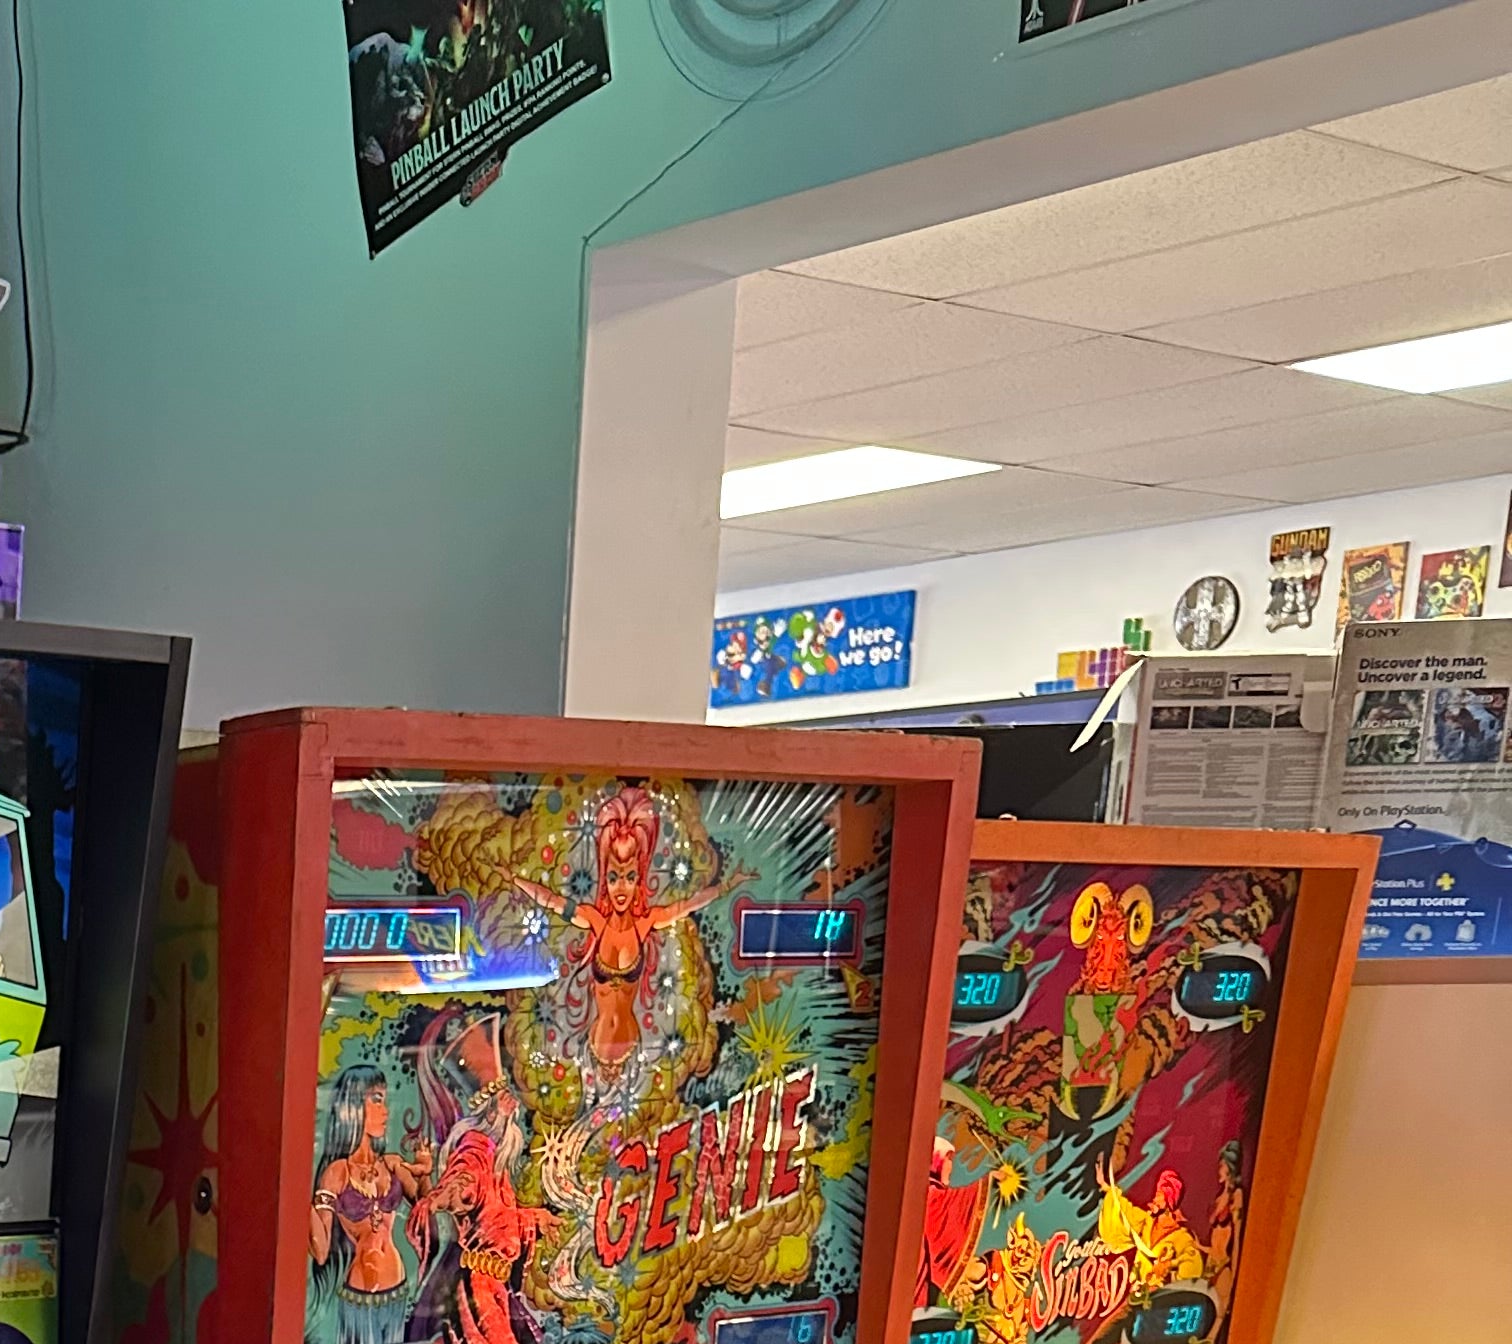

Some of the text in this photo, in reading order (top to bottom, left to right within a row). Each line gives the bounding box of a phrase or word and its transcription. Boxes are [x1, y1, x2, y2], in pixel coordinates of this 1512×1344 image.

[391, 125, 450, 190] PINBALL
[451, 79, 510, 145] LAUNCH
[512, 38, 564, 100] PARTY
[1271, 527, 1331, 557] GUNDAM
[848, 625, 896, 648] Here
[1354, 628, 1401, 639] SONY
[839, 640, 903, 667] we go!
[1359, 656, 1488, 670] Discover the man.
[1357, 668, 1488, 683] Uncover a legend.
[1338, 806, 1361, 818] Only
[1363, 806, 1378, 817] On
[1406, 879, 1425, 889] Plus
[1390, 898, 1418, 907] MORE
[957, 973, 1000, 1005] 320
[1212, 972, 1251, 1002] 320
[595, 1063, 818, 1267] GENIE
[1163, 1305, 1203, 1336] 320
